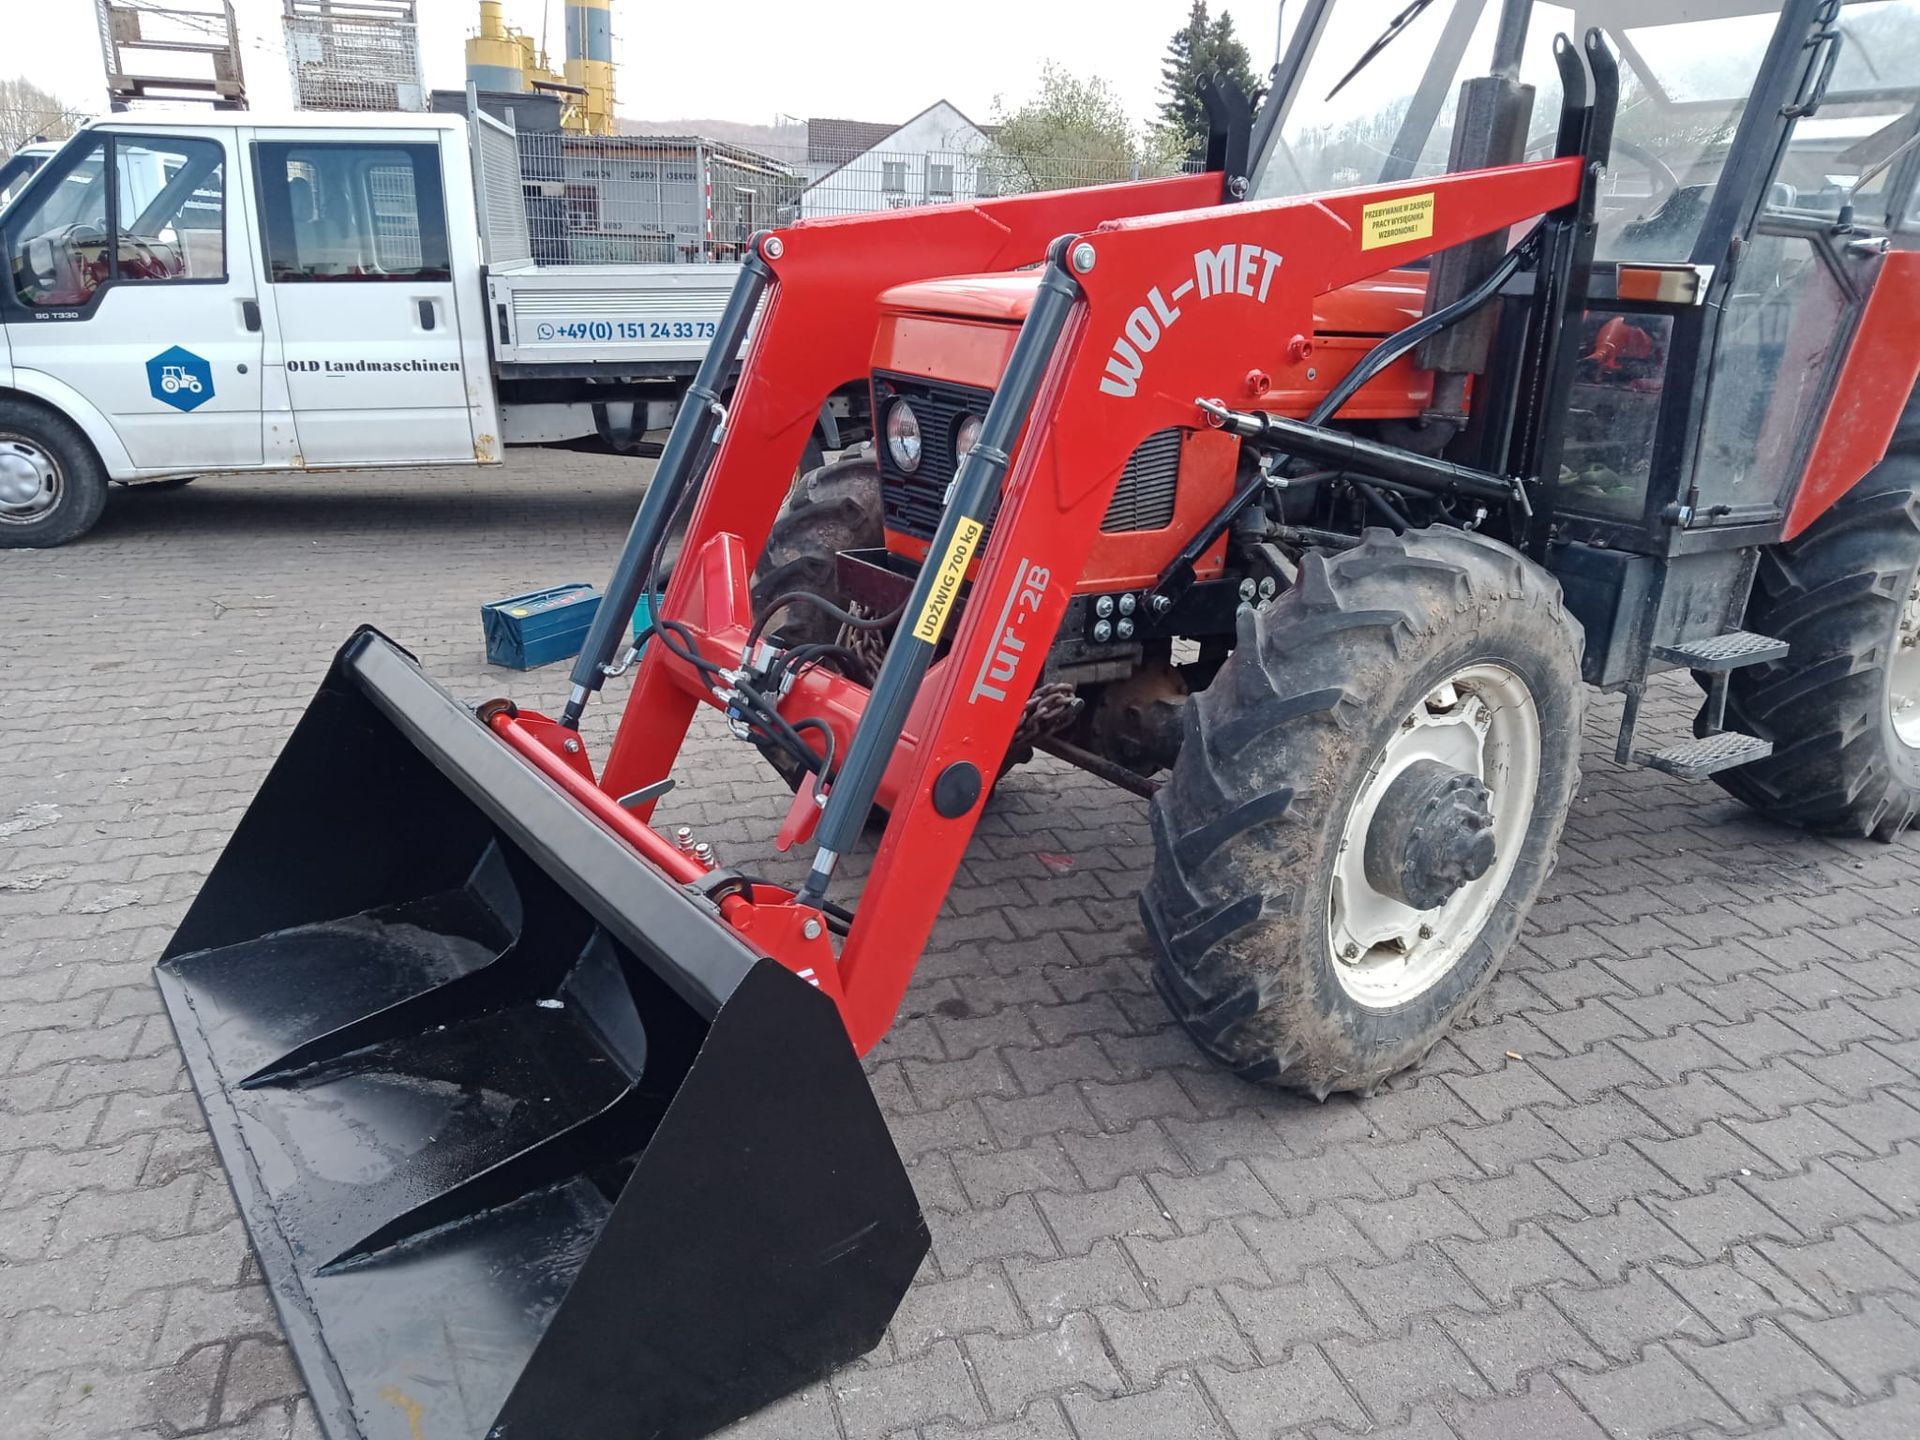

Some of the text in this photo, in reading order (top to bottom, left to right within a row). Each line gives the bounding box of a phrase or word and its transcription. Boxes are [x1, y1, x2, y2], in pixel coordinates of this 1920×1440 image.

[1365, 199, 1433, 219] PRZEBYWANIE W ZASIĘGU
[1372, 212, 1424, 229] PRACY WYSIĘGNIKA
[1099, 243, 1284, 397] WOL-MET
[557, 322, 716, 340] +49(0) 151 24 33 73
[287, 359, 460, 372] OLD Landmaschinen
[921, 524, 978, 637] UDŹWIG 700 kg
